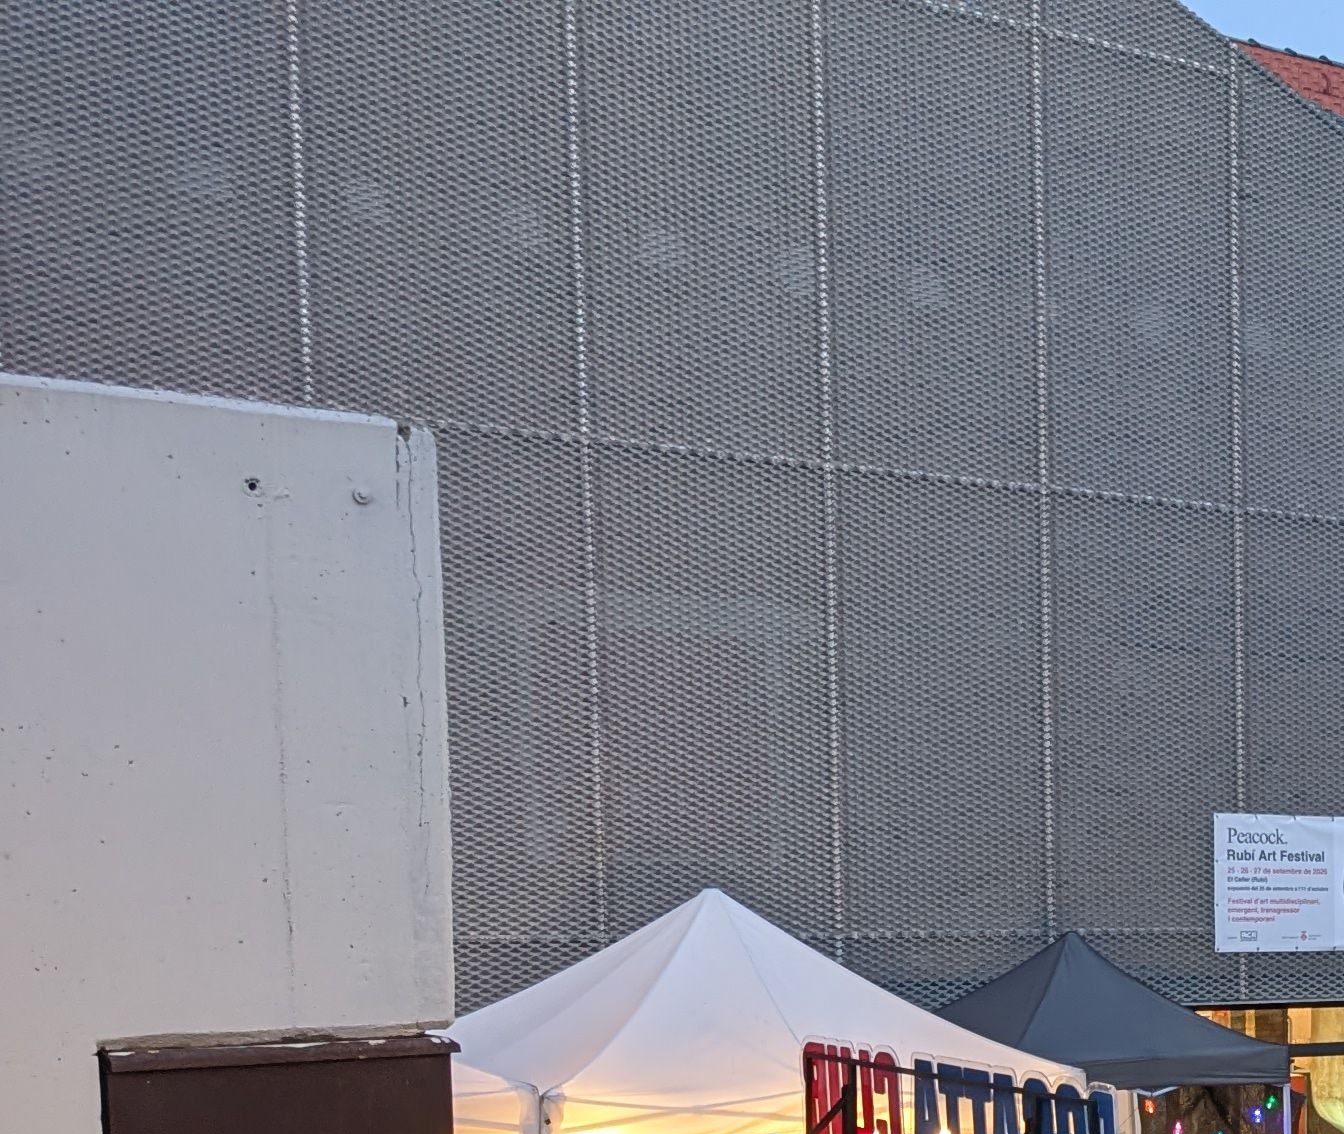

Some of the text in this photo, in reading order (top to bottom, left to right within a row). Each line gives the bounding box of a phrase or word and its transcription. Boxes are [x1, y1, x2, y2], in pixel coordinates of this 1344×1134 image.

[1227, 849, 1325, 862] Rubí Art Festival
[1272, 867, 1302, 875] setembre
